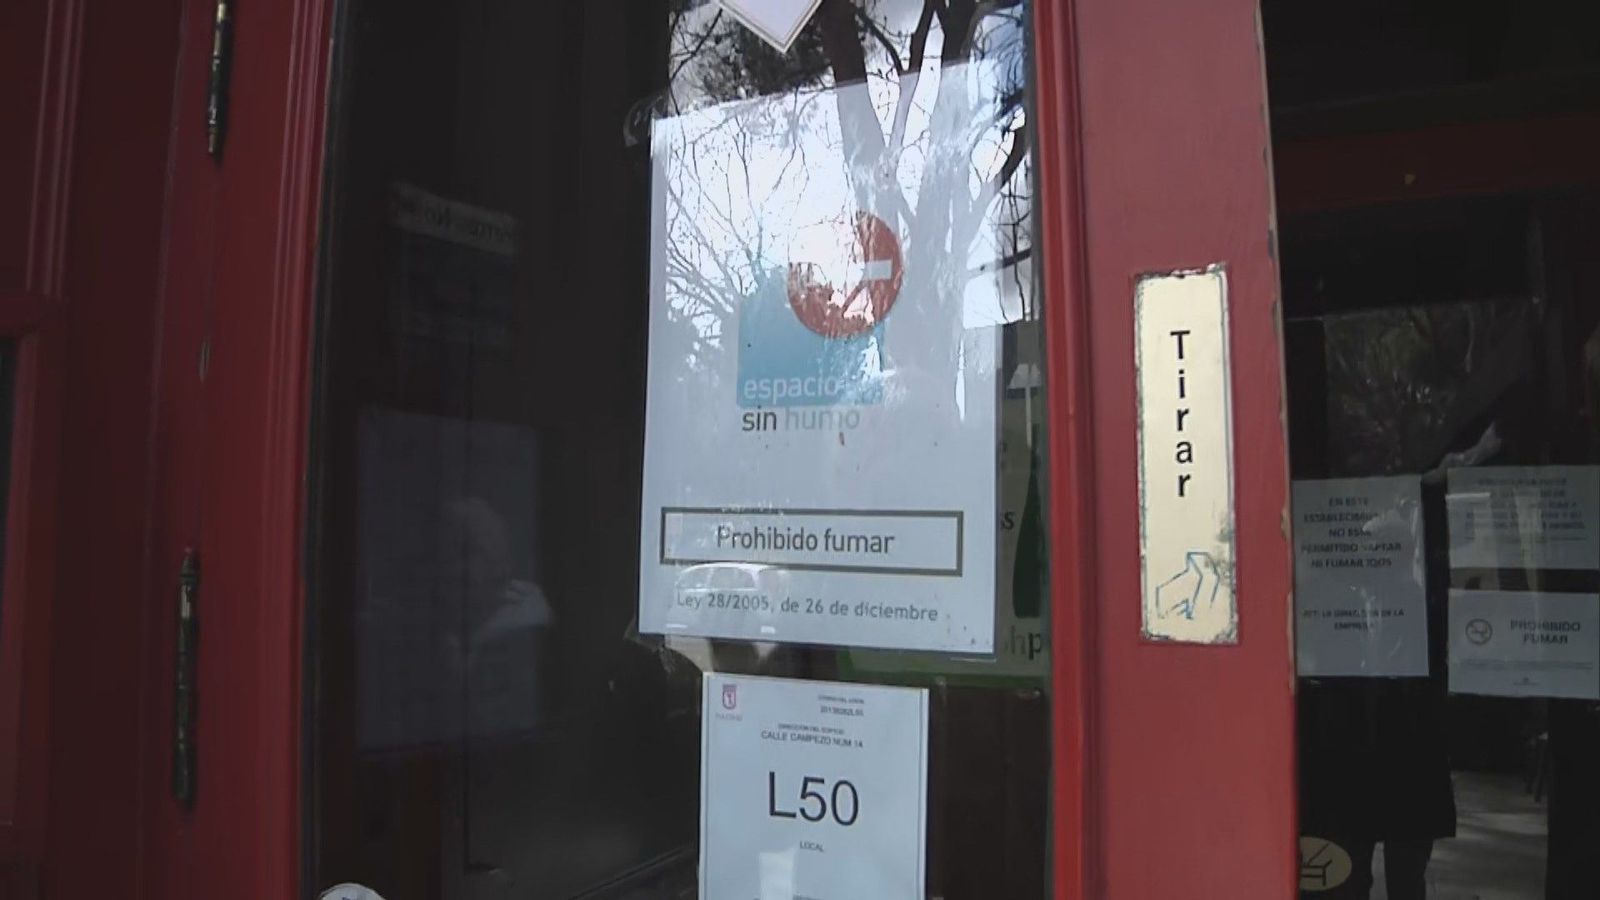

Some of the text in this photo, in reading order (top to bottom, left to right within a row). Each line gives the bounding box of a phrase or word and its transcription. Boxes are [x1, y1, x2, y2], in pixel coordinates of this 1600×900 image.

[743, 375, 839, 404] espacio
[742, 406, 860, 432] sin humo
[1170, 329, 1193, 498] Tirar
[717, 525, 896, 554] Prohibido fumar
[677, 592, 938, 622] Ley 28/2005, de 26 de diciembre
[761, 729, 787, 742] CALLE
[769, 771, 859, 827] L50
